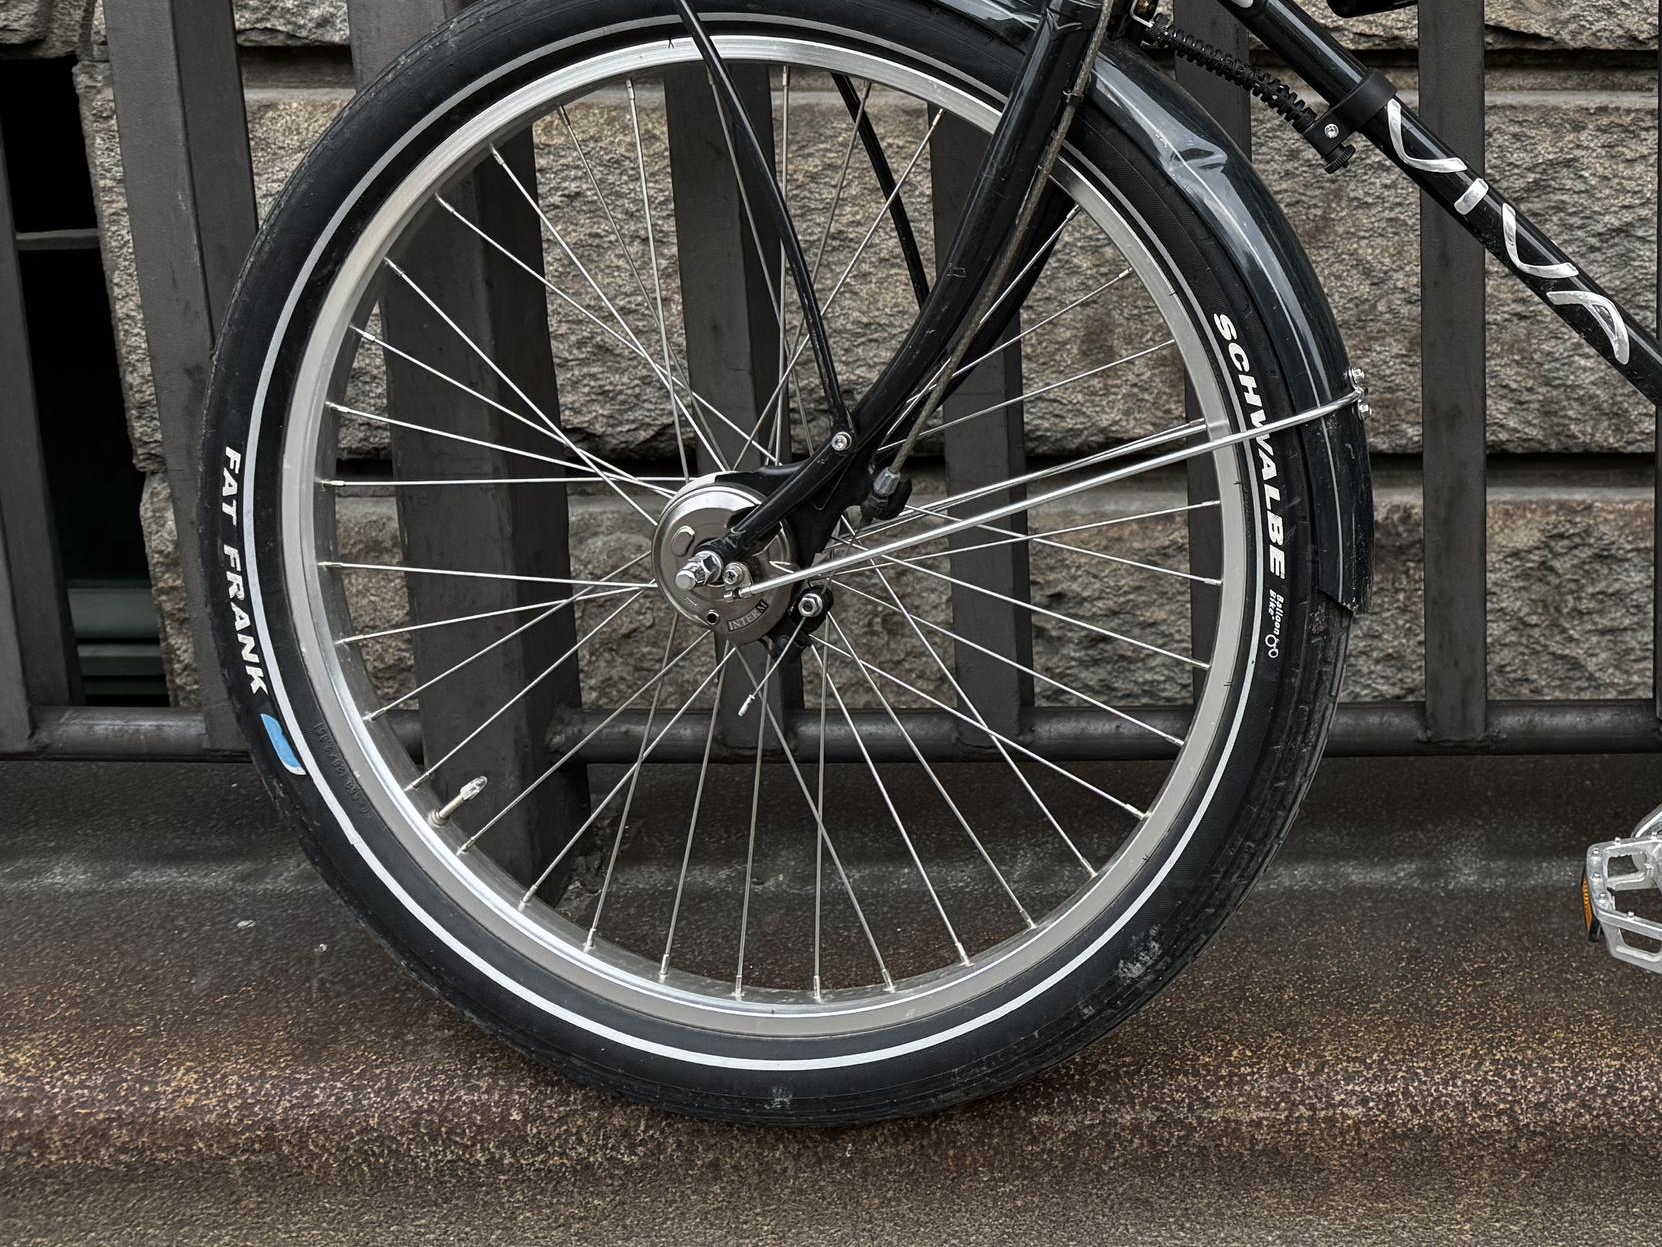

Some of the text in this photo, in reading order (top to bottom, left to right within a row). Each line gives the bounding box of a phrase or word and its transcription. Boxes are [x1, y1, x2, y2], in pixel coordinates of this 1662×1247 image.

[222, 446, 269, 695] FAT FRANK
[1213, 312, 1285, 580] SCHWALBE
